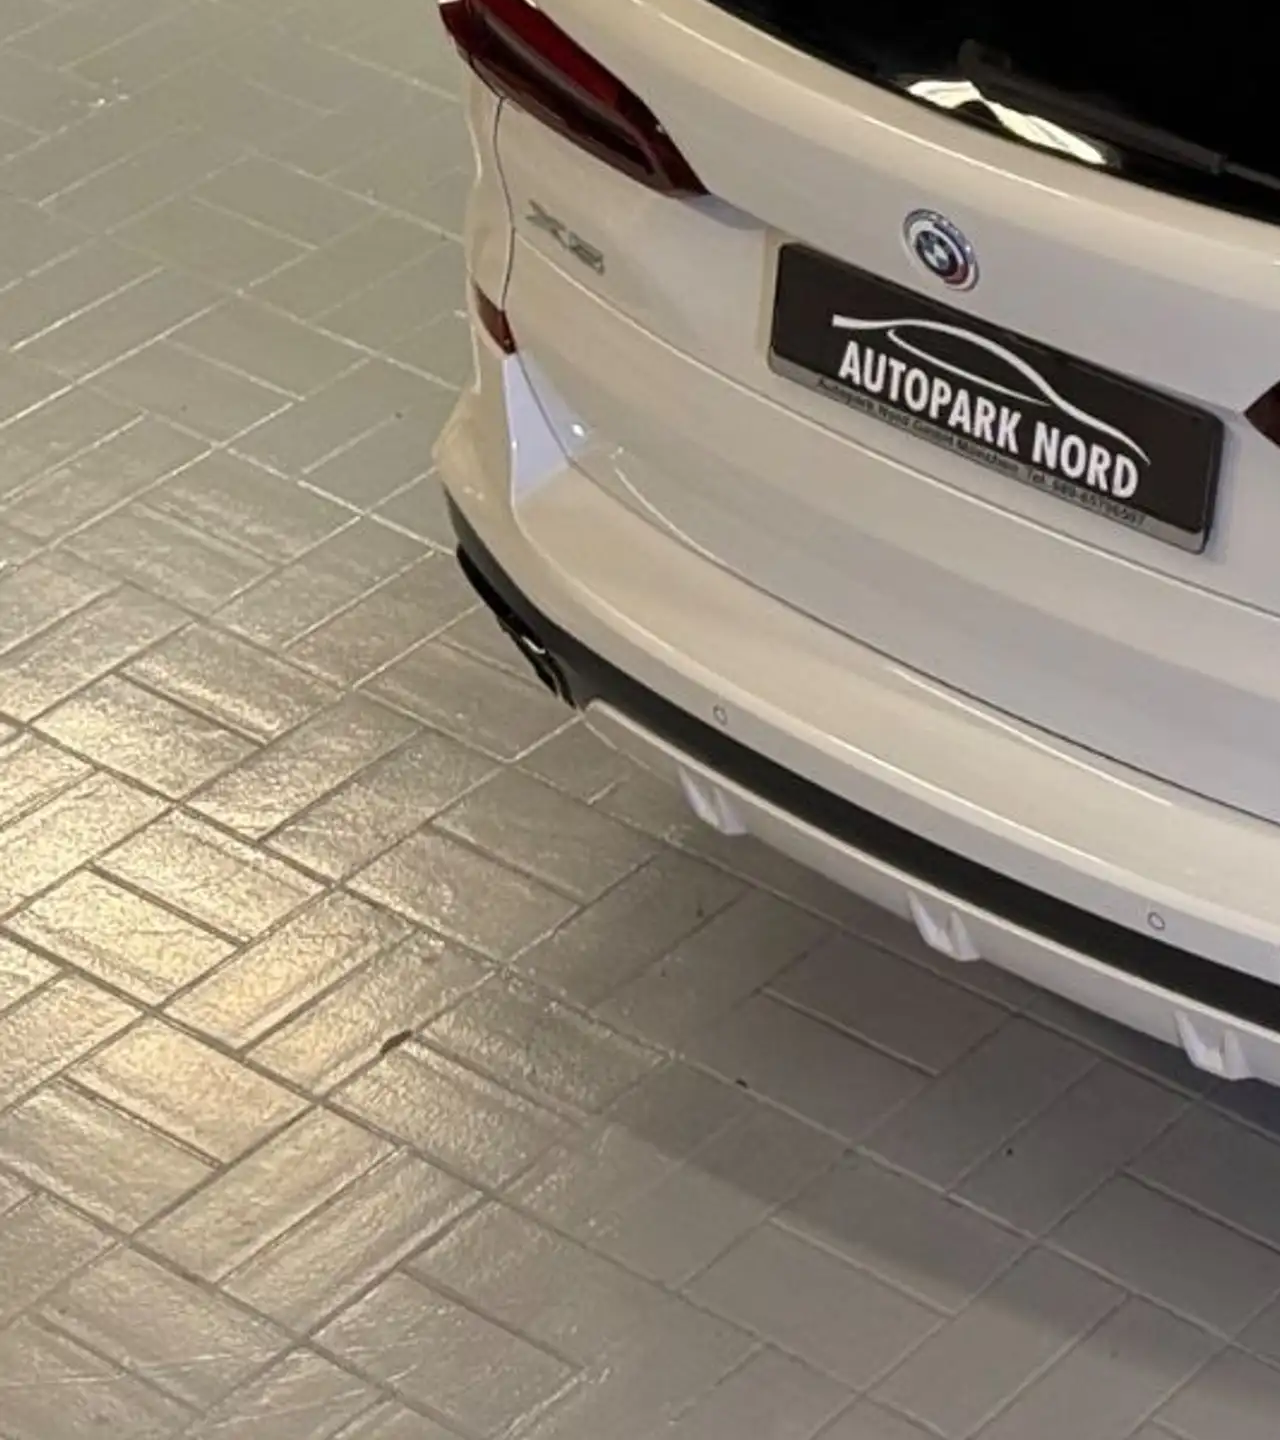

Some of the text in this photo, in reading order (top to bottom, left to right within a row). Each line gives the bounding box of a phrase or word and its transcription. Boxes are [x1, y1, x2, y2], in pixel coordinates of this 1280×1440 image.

[524, 199, 606, 276] X5
[838, 340, 1139, 499] AUTOPARK NORD
